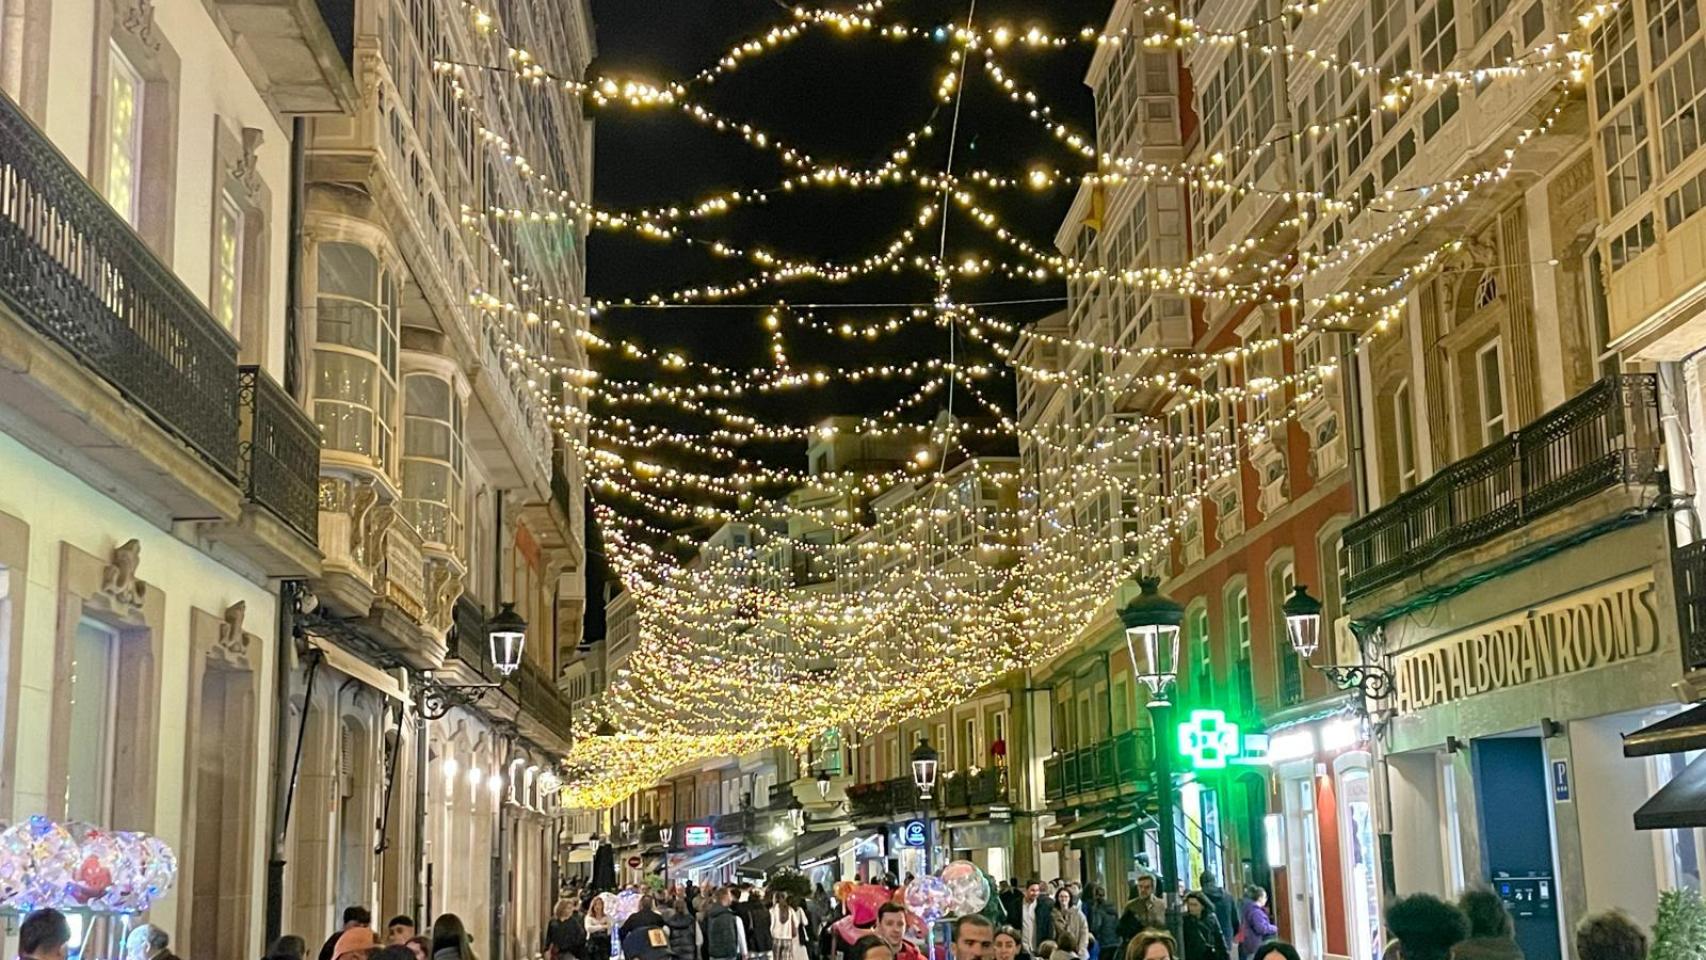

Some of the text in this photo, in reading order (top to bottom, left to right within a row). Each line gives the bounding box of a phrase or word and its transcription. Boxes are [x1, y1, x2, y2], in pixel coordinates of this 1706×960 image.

[1397, 583, 1658, 712] ALDA ALBORÁN ROOMS
[1557, 762, 1566, 785] P
